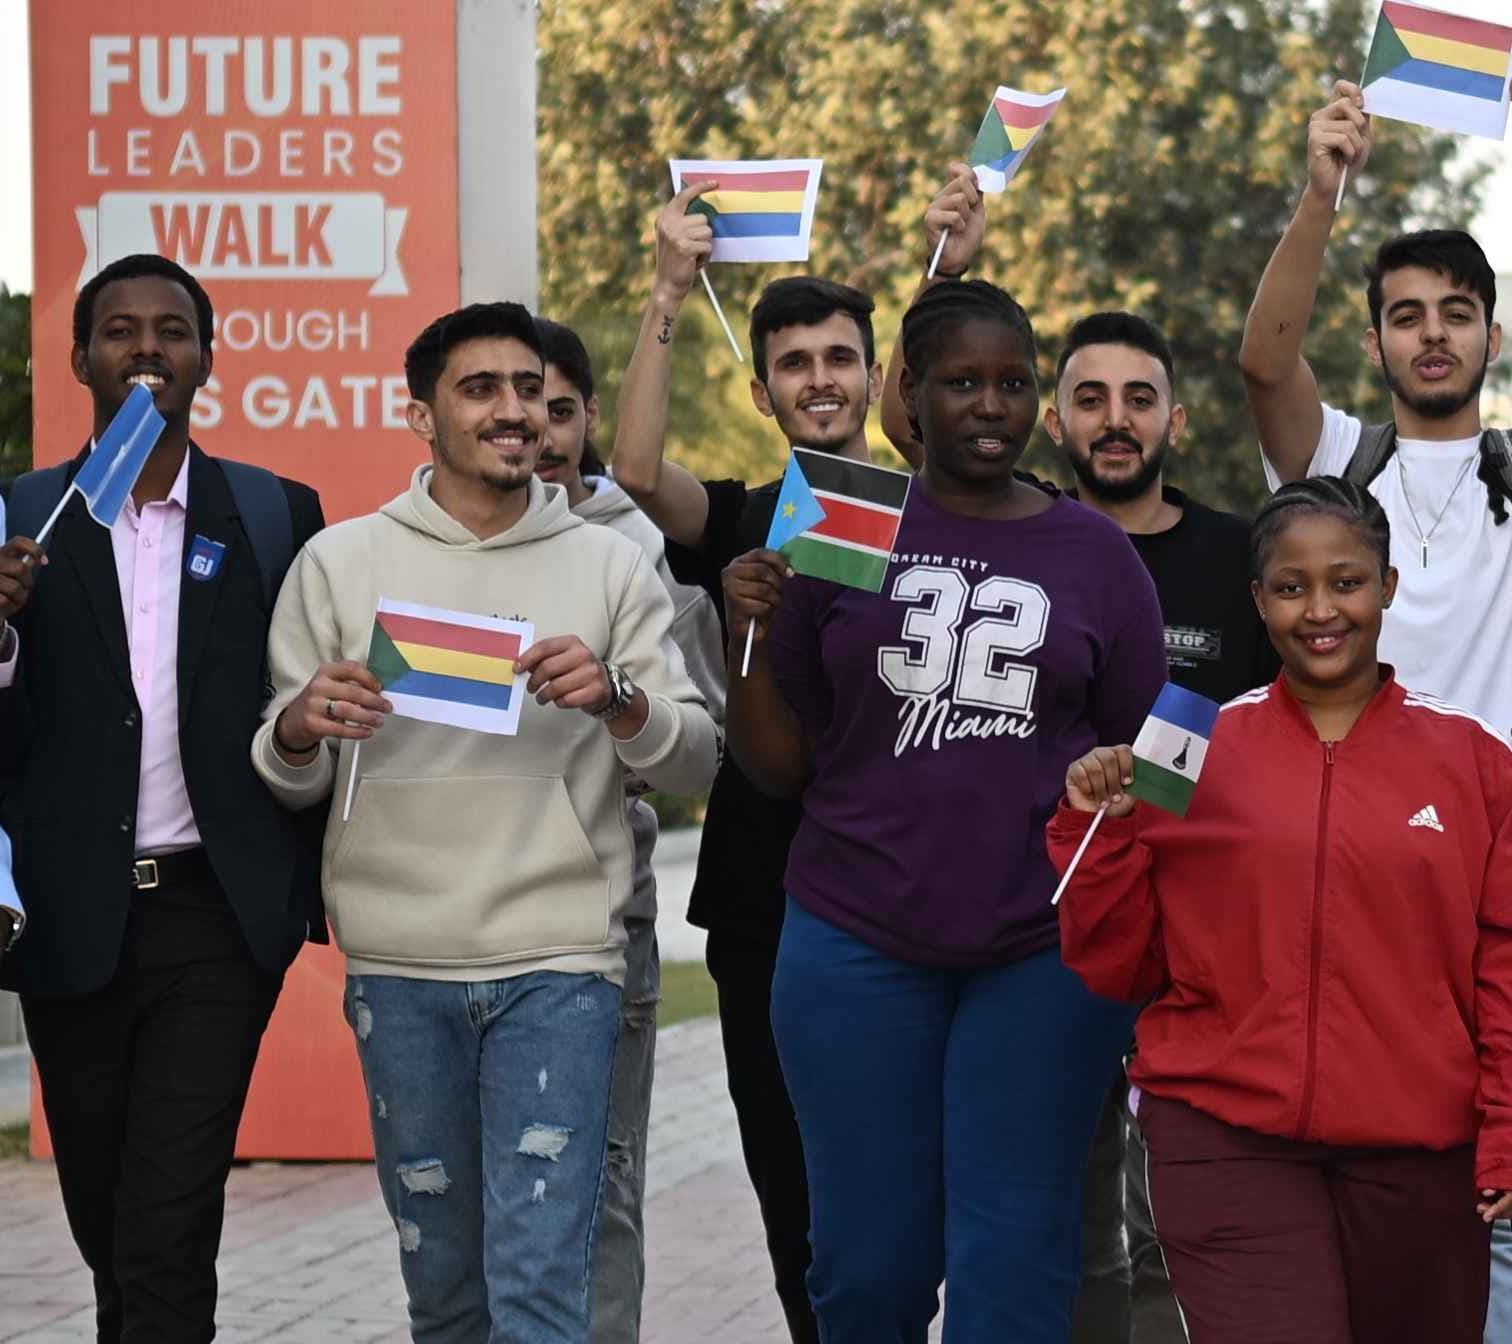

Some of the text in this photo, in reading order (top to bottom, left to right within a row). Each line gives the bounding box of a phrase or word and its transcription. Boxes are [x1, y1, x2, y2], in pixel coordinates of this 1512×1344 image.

[89, 35, 402, 117] FUTURE
[88, 128, 405, 177] LEADERS
[149, 203, 334, 268] WALK
[213, 310, 369, 351] OUGH
[242, 375, 409, 429] GATE
[951, 557, 988, 572] CITY
[878, 564, 1051, 715] 32
[893, 694, 1037, 758] Miami
